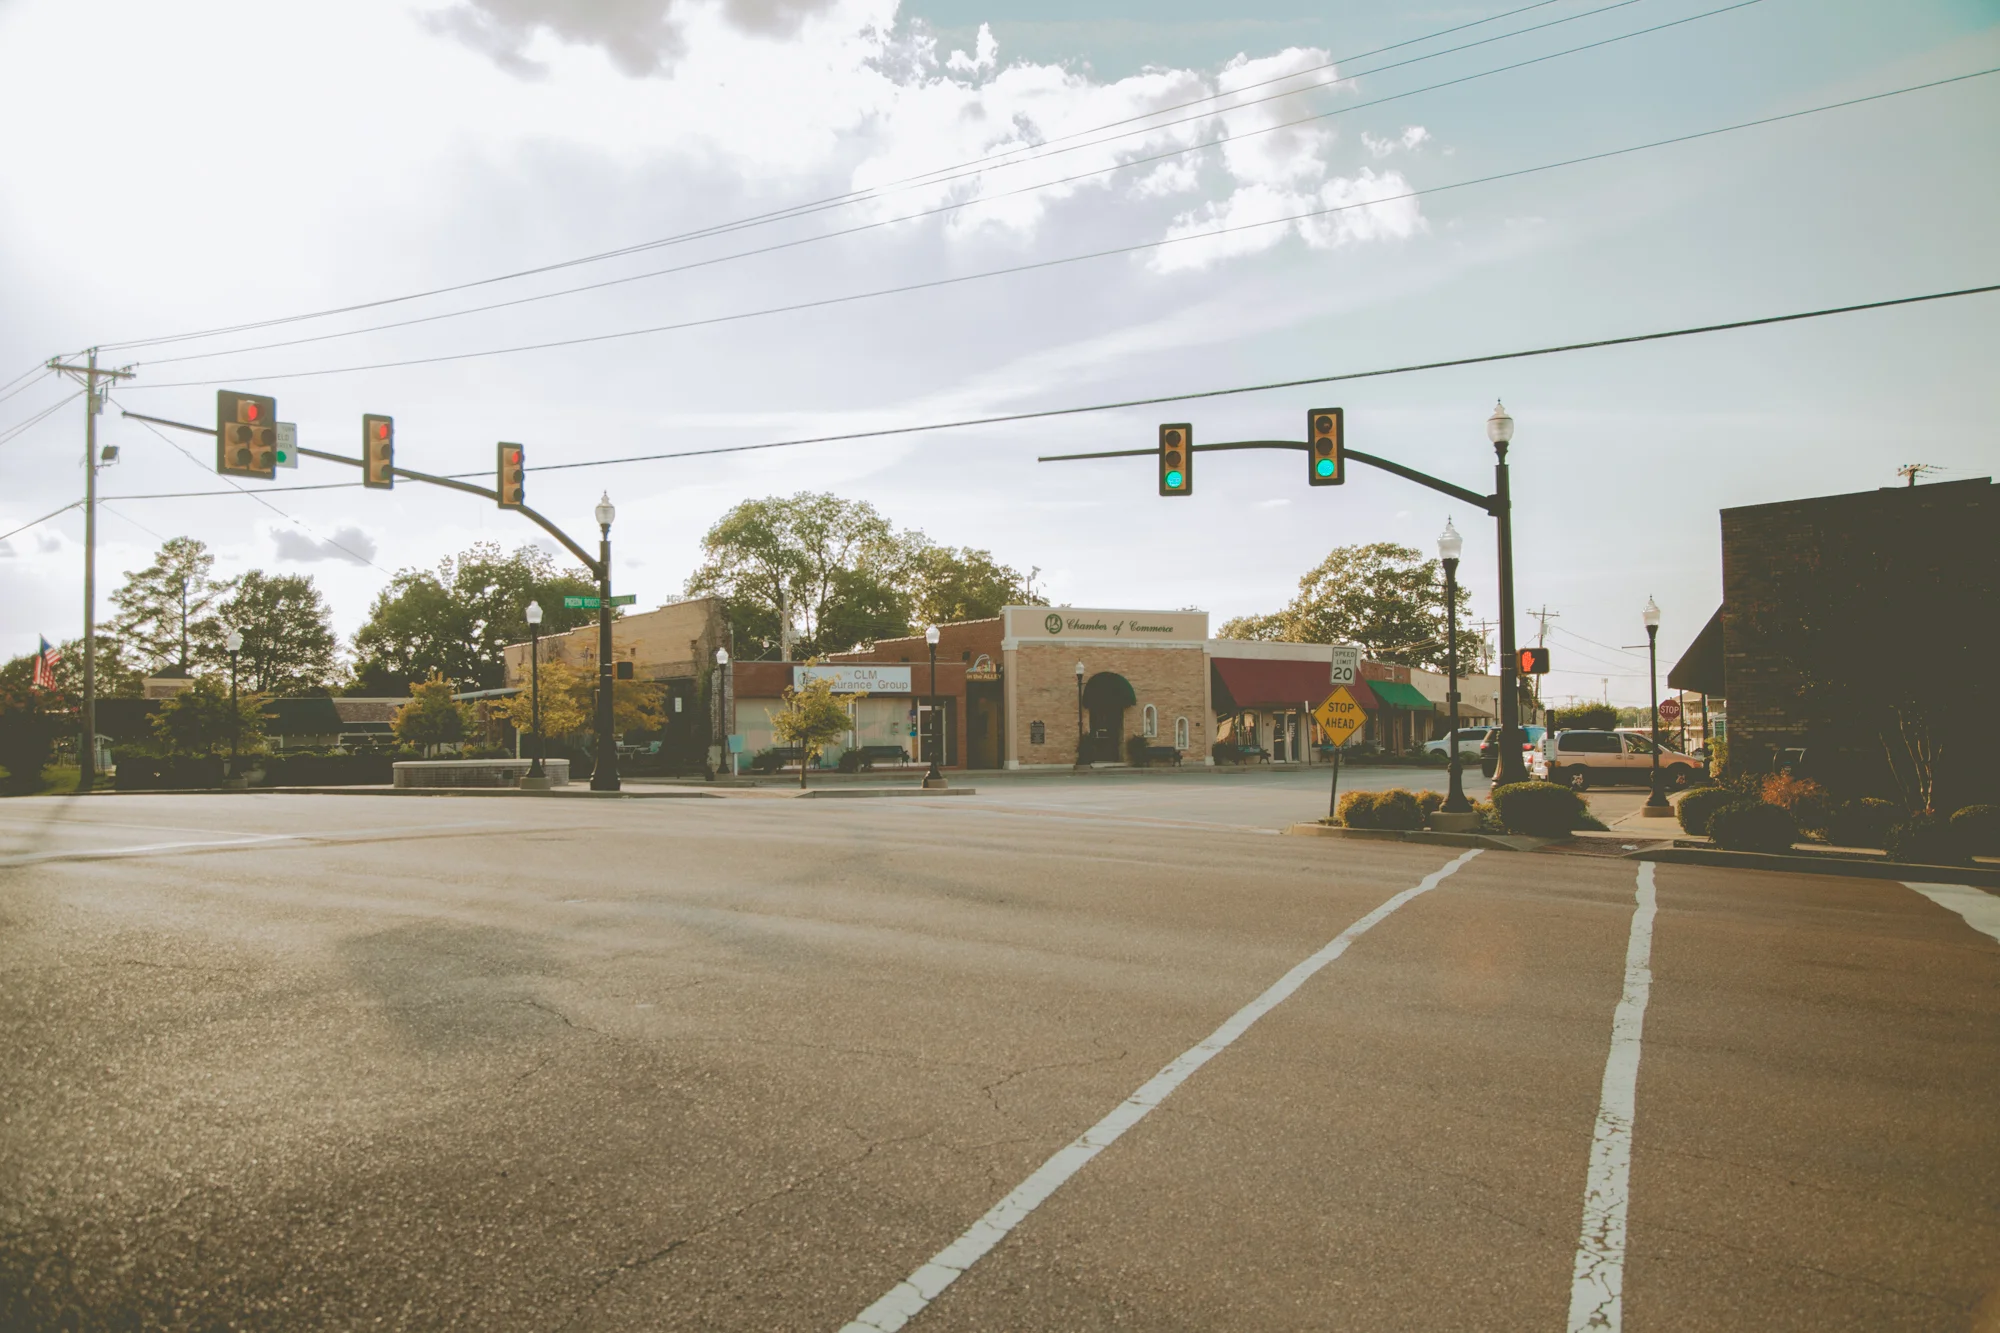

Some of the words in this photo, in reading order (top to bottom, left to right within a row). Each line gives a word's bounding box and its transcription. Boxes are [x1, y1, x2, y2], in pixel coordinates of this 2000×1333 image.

[1066, 618, 1107, 631] Chamber
[1112, 620, 1124, 635] of
[1129, 619, 1173, 633] Commerce
[854, 669, 877, 680] CLM
[1333, 667, 1353, 680] 20
[831, 681, 872, 689] surance
[878, 680, 908, 691] Group
[1328, 702, 1354, 713] STOP
[1661, 705, 1679, 714] STOP
[1325, 717, 1354, 730] AHEAD
